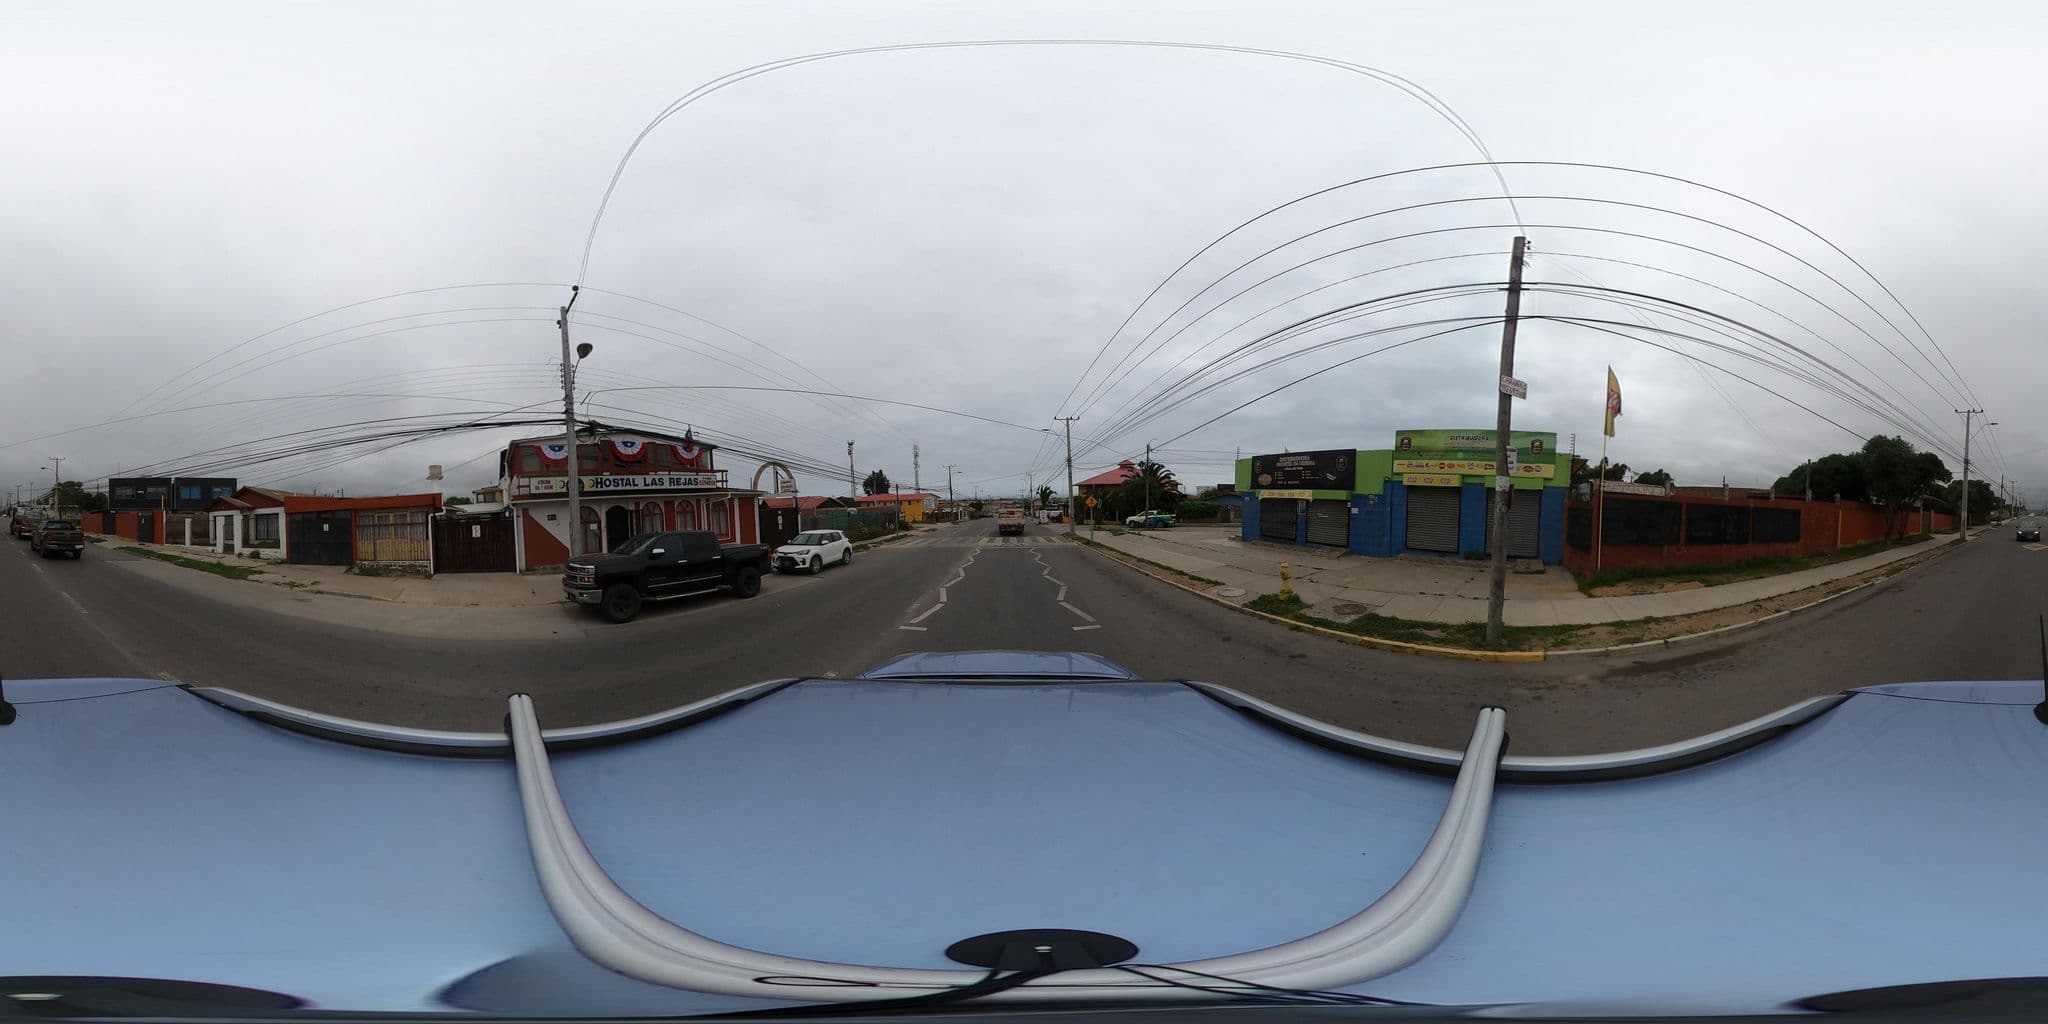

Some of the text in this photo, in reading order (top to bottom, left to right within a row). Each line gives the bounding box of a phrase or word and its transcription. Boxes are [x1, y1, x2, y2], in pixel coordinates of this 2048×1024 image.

[595, 477, 639, 489] HOSTAL
[643, 477, 665, 488] LAS
[669, 477, 699, 487] REJAS
